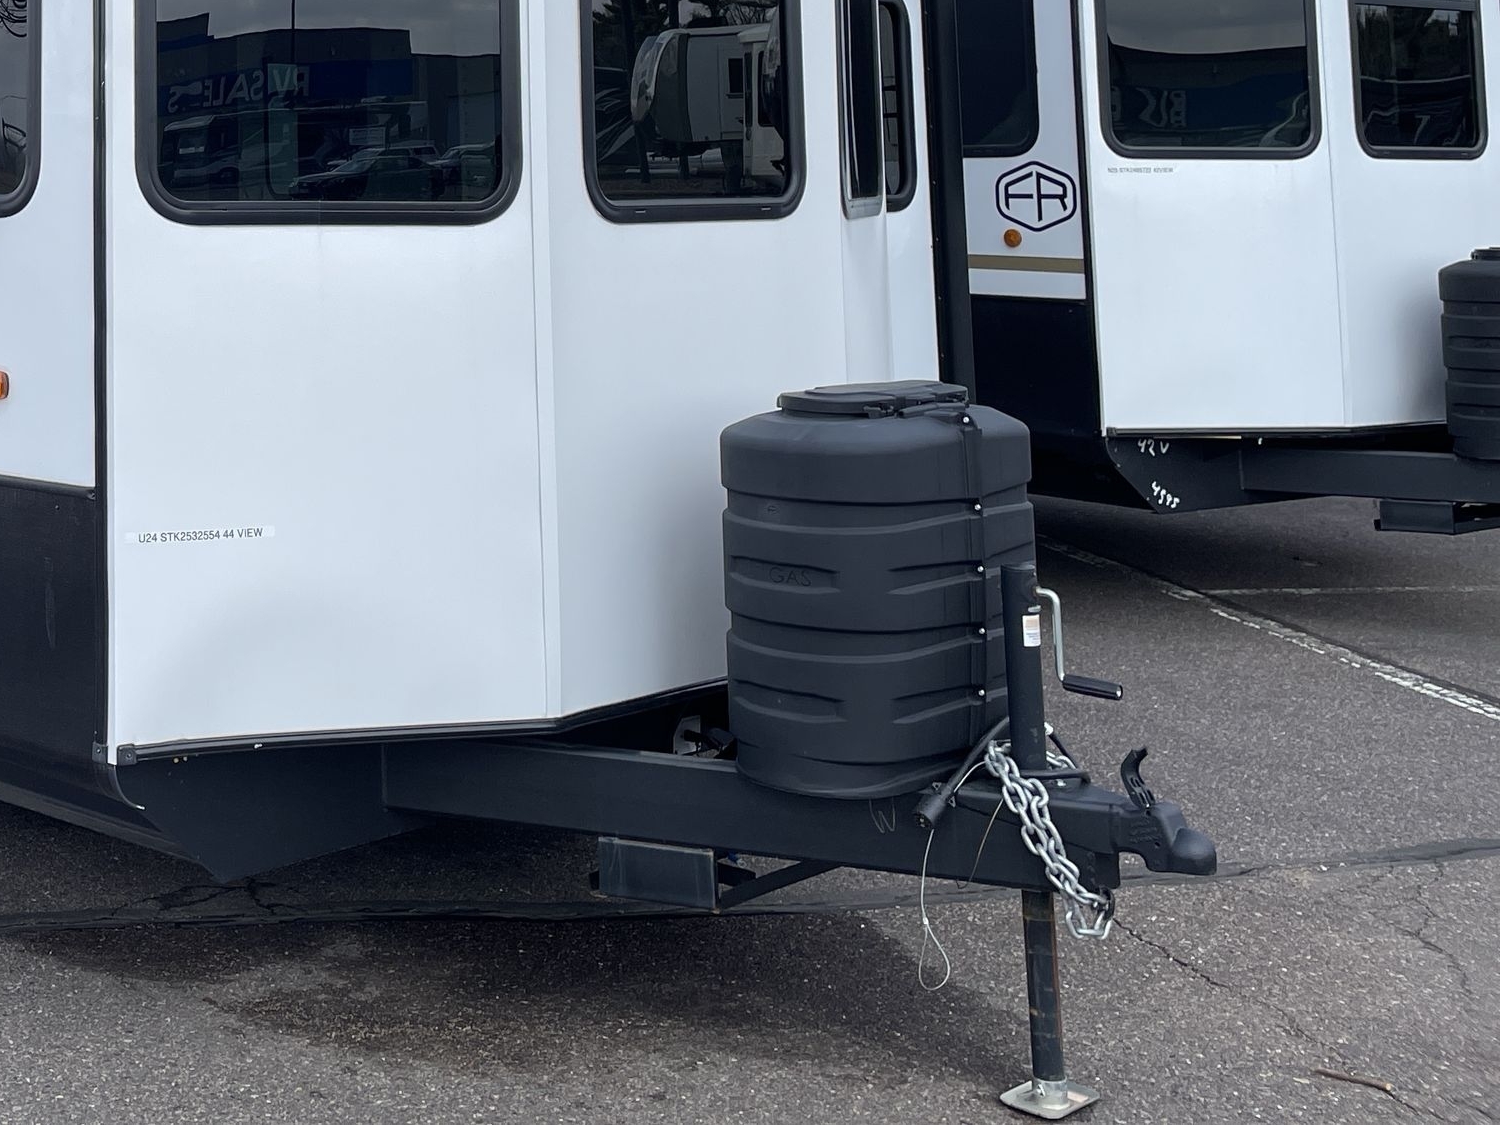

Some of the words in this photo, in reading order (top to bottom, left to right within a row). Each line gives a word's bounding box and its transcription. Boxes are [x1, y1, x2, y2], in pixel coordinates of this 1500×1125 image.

[138, 532, 158, 544] U24
[160, 530, 221, 543] STK2532554
[222, 529, 235, 539] 44
[236, 527, 264, 538] VIEW
[769, 566, 812, 587] GAS
